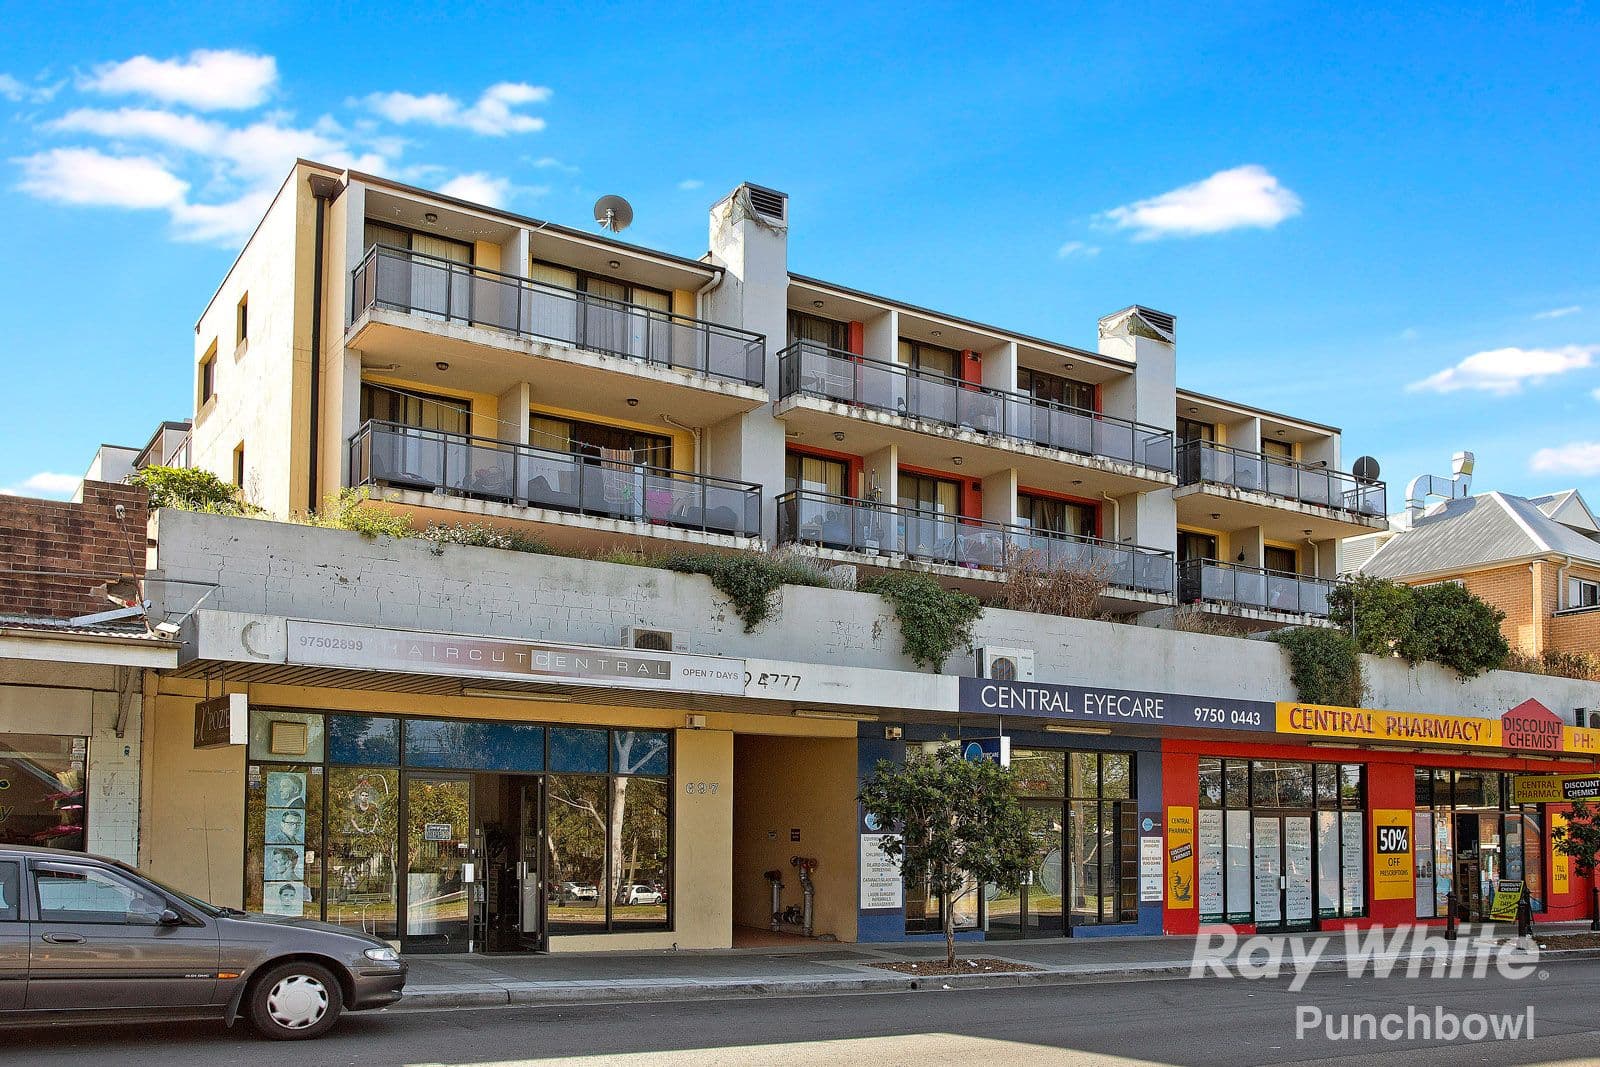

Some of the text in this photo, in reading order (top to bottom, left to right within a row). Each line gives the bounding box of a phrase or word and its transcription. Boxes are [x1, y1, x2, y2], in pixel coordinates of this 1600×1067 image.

[300, 635, 364, 651] 97502899
[393, 644, 667, 676] AIRCUT CENTRAL
[682, 668, 739, 680] OPEN 7 DAYS
[981, 685, 1261, 726] CENTRAL EYECARE 9750 0443
[1289, 707, 1482, 742] CENTRAL PHARMACY
[1503, 717, 1562, 735] DISCOUNT
[1508, 732, 1559, 749] CHEMIST
[1521, 780, 1557, 789] CENTRAL
[1564, 780, 1600, 790] DISCOUNT
[1567, 788, 1598, 797] CHEMIST
[1517, 789, 1562, 798] PHARMACY
[1380, 828, 1407, 851] 50%
[1388, 857, 1401, 867] OFF
